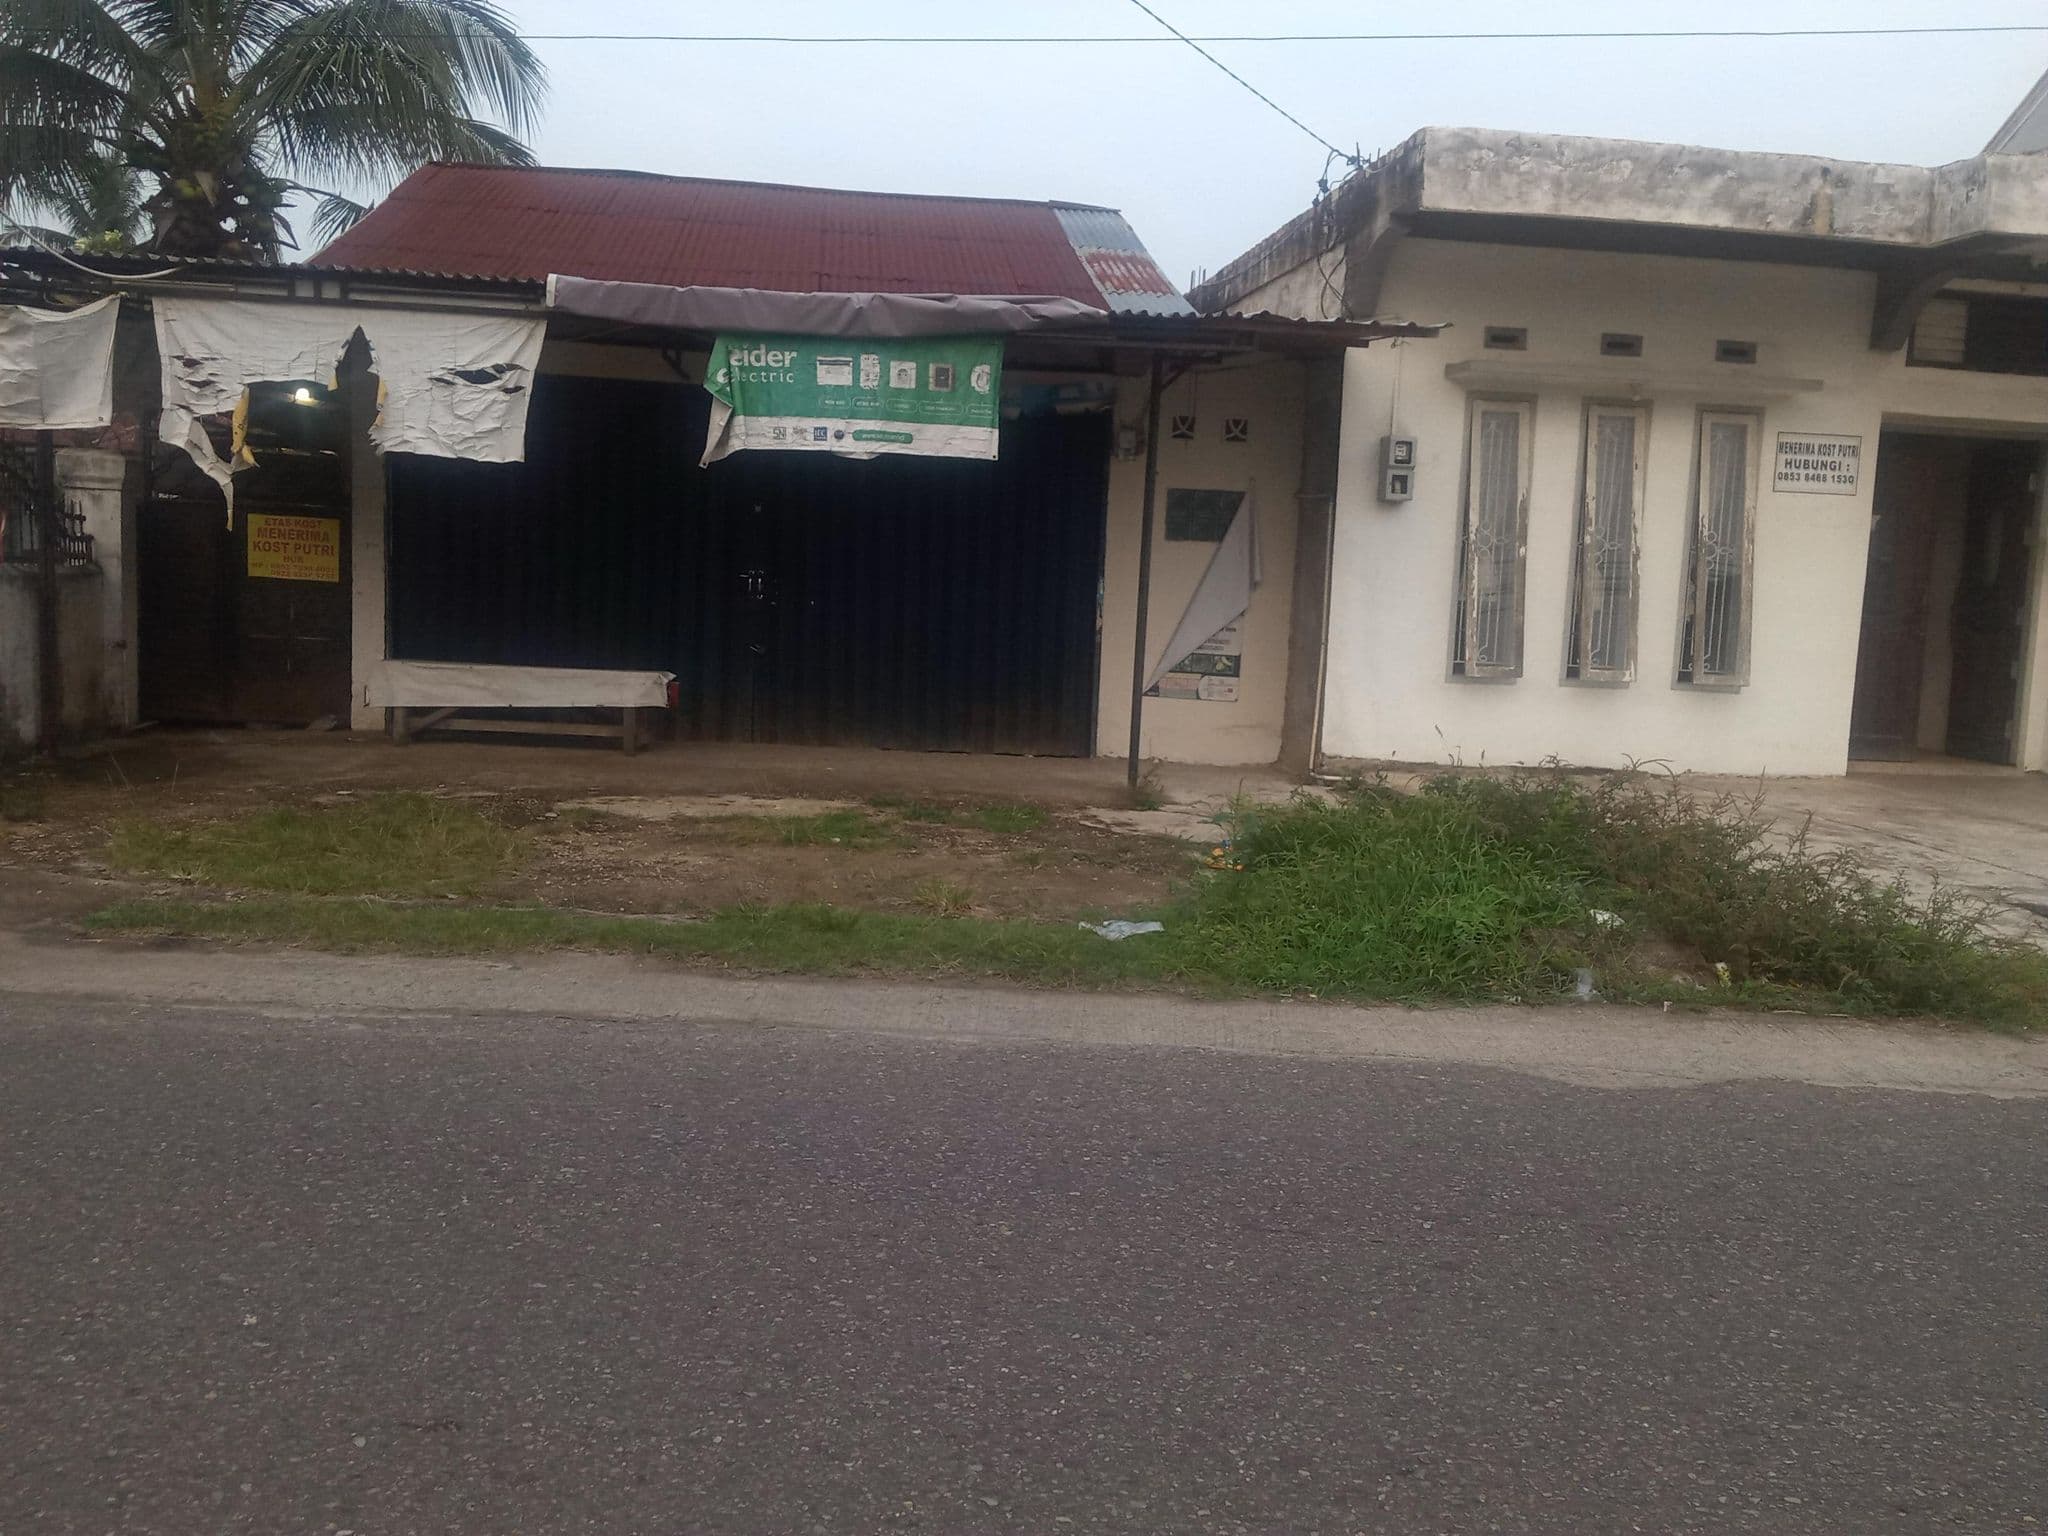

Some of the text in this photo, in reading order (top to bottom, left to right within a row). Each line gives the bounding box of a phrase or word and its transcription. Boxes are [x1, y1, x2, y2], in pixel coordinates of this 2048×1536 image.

[1778, 441, 1858, 458] MENERIMA KOST PUTRI
[1784, 458, 1842, 471] HUBUNGI
[257, 528, 329, 541] MENERIMA
[253, 542, 335, 556] KOST PUTRI
